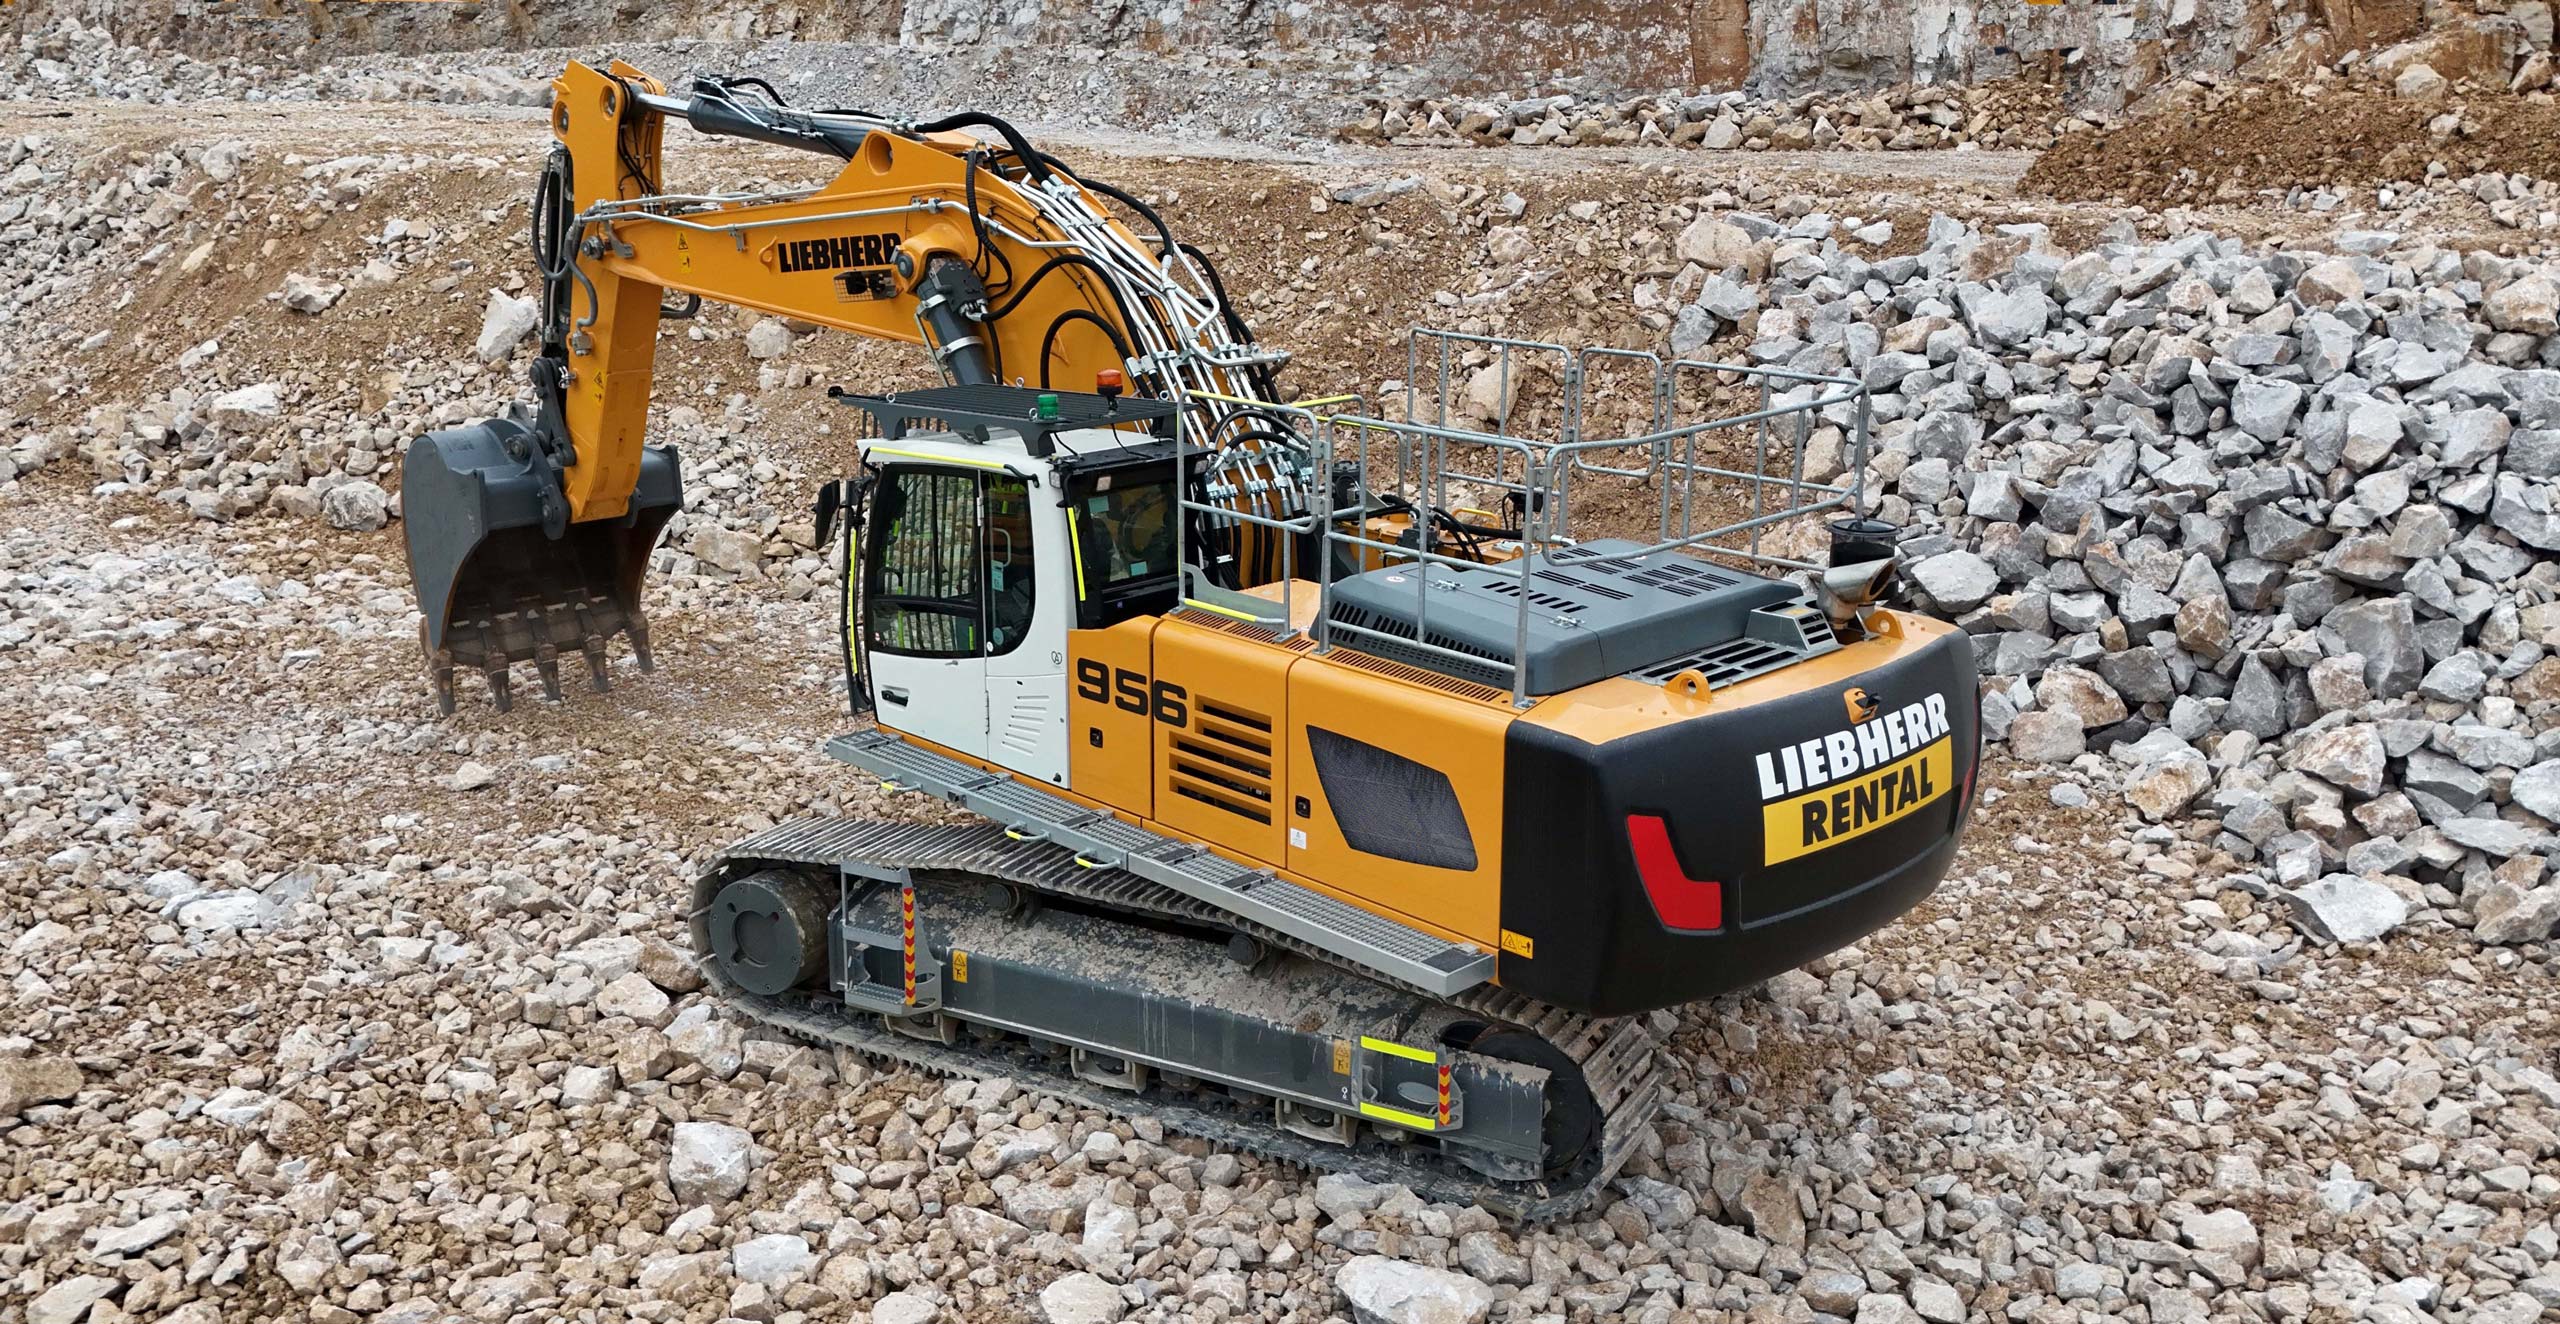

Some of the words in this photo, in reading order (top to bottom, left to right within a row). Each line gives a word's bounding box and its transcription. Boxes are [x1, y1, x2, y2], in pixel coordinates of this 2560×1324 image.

[1077, 657, 1187, 729] 956
[1755, 692, 1950, 800] LIEBHERR
[1802, 756, 1933, 847] RENTAL
